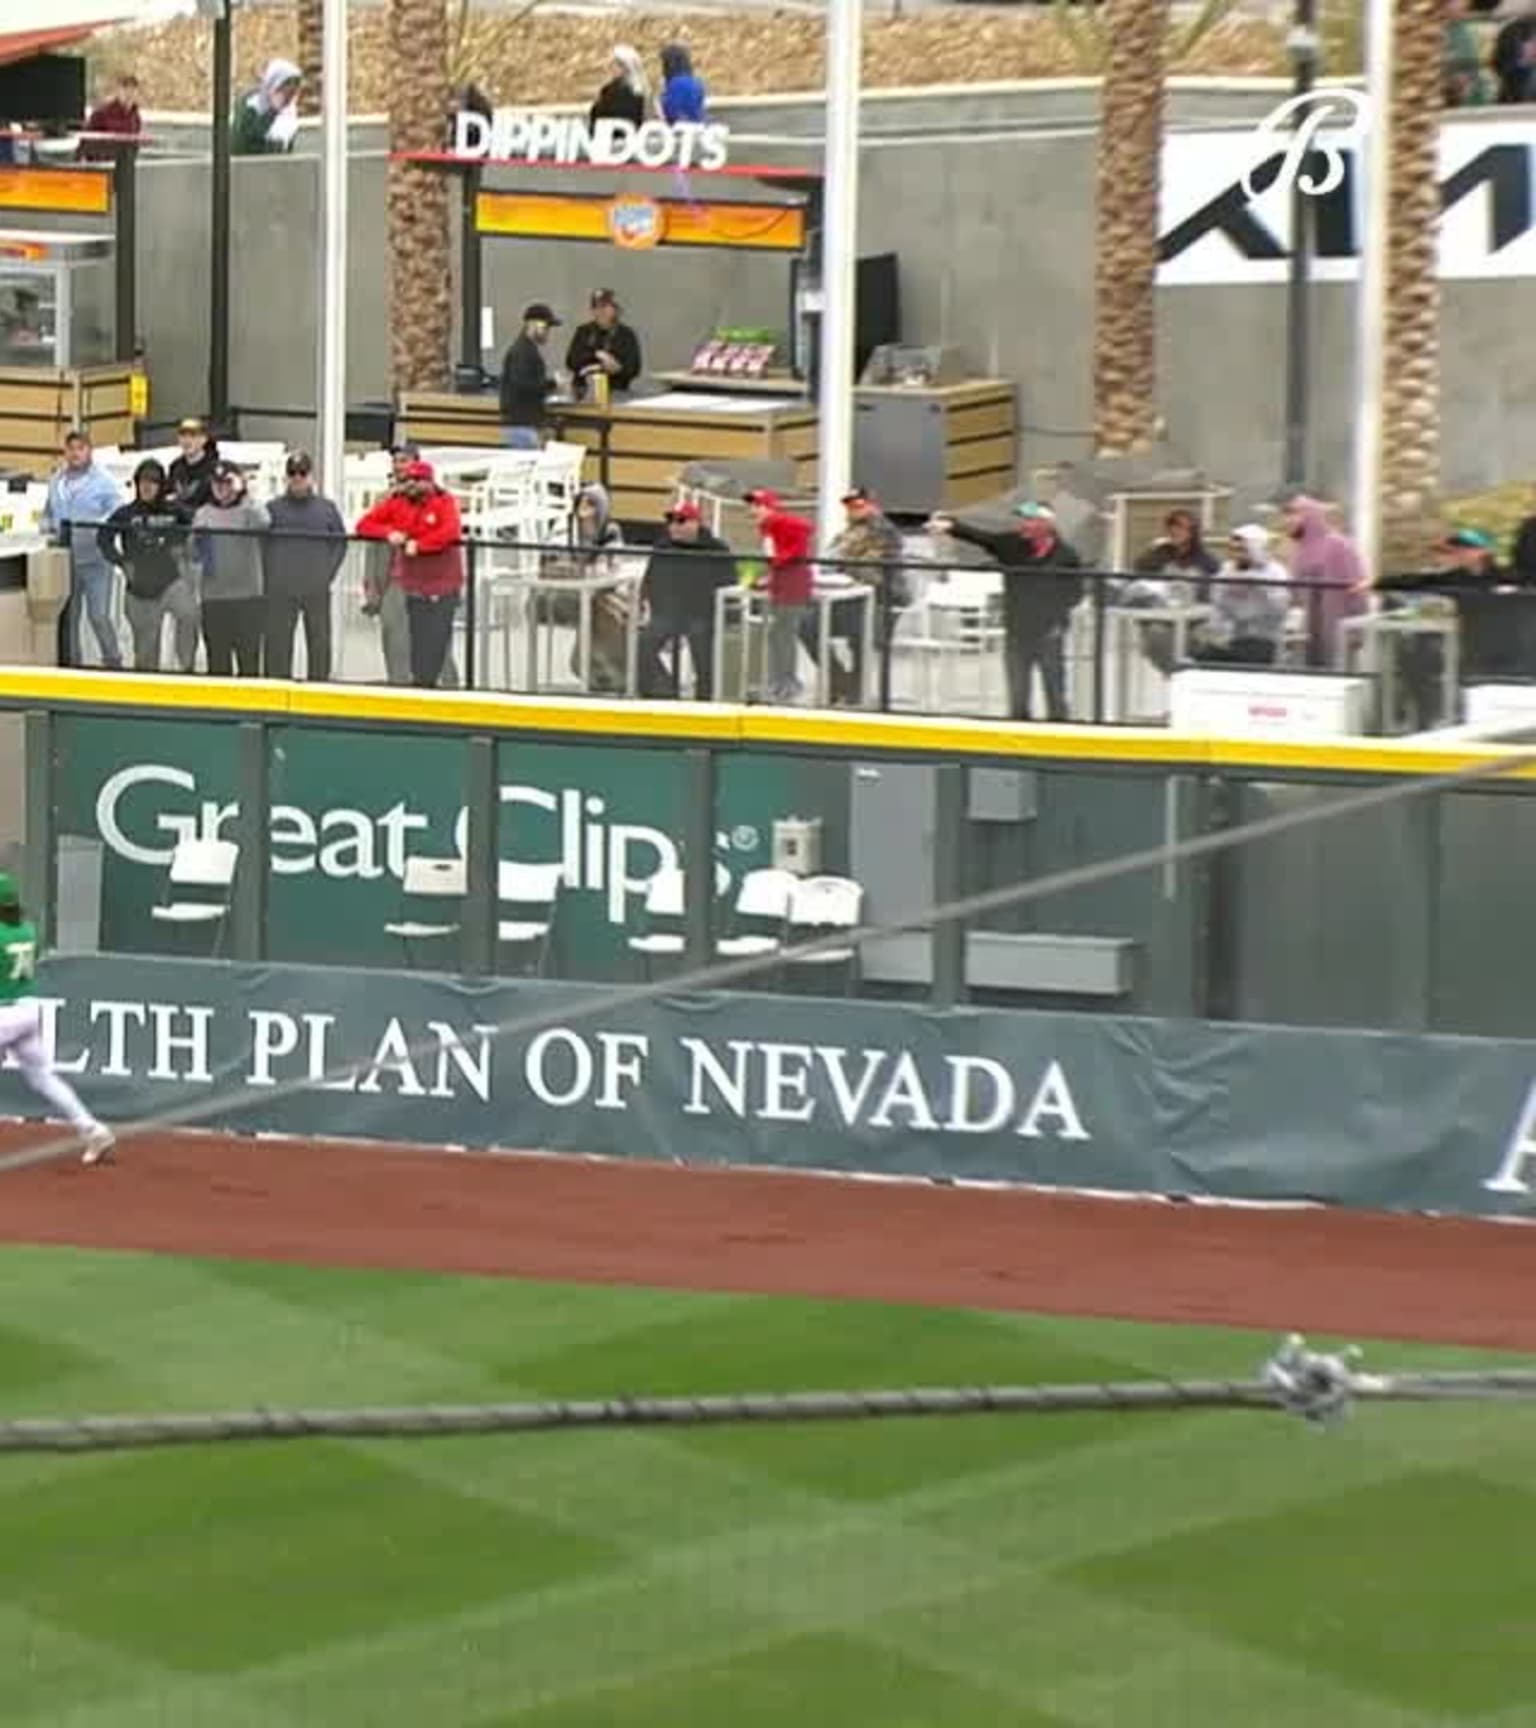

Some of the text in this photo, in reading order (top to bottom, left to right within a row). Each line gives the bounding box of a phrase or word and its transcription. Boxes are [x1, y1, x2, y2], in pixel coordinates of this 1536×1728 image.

[96, 764, 427, 880] Great
[247, 1010, 498, 1102] PLAN
[526, 1027, 648, 1109] OF
[680, 1036, 1092, 1140] NEVADA
